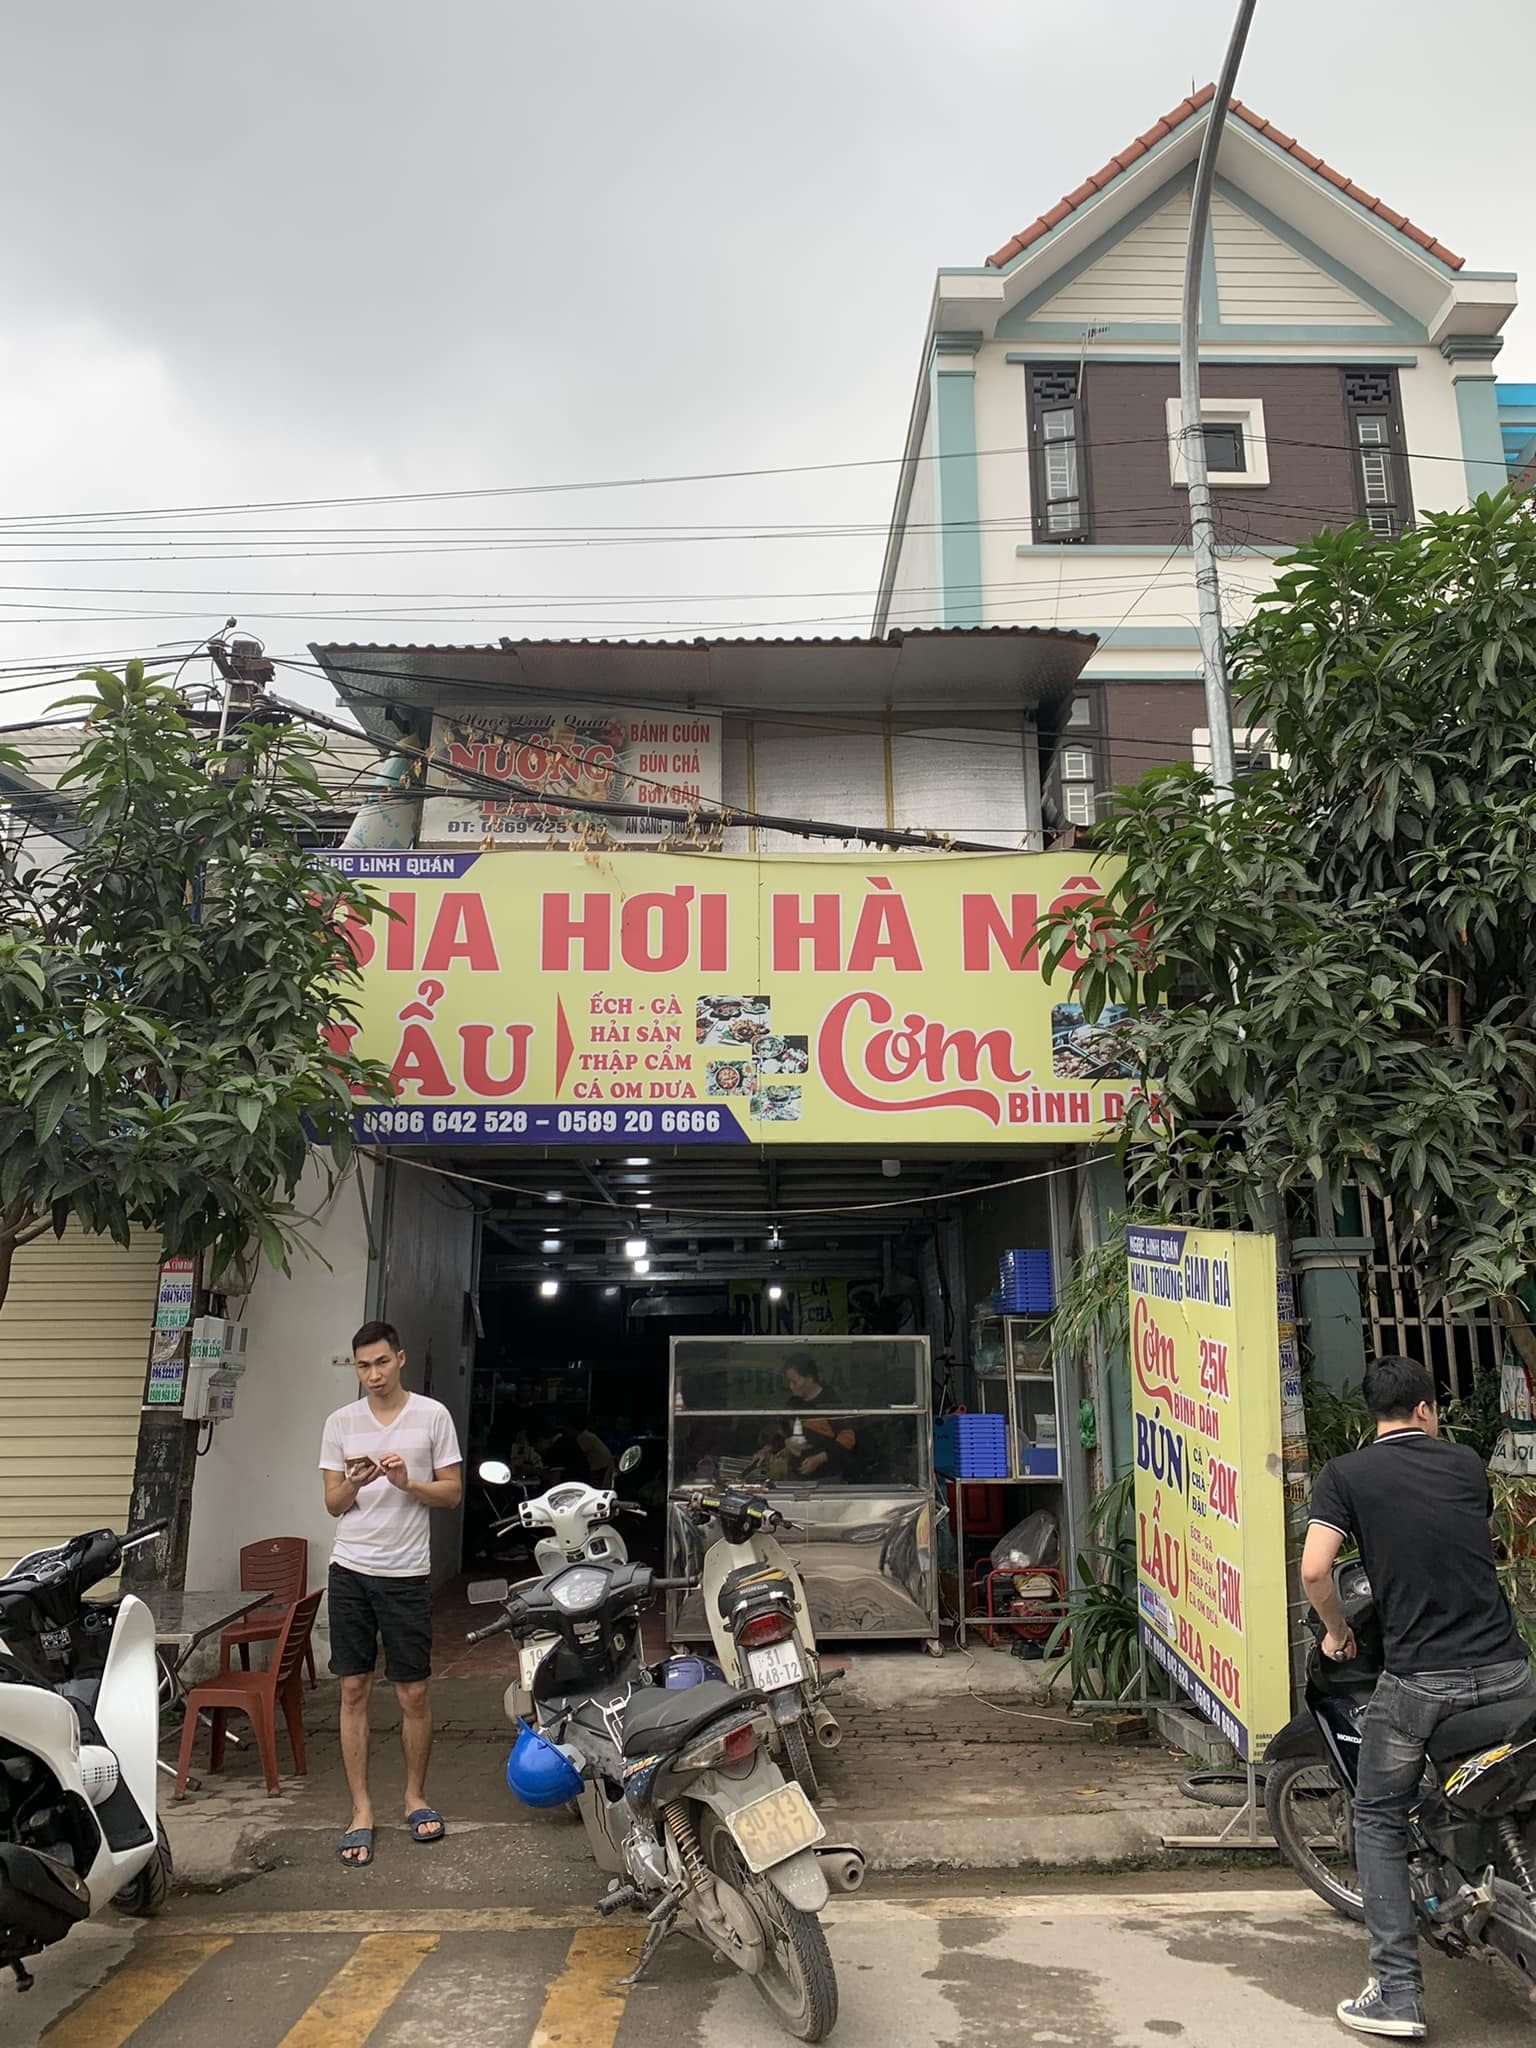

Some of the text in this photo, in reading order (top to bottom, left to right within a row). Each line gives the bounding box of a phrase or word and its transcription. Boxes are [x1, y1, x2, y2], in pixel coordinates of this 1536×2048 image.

[631, 717, 711, 743] BÁNH CUỐN
[639, 748, 700, 773] BÚN CHẢ
[448, 821, 475, 834] ĐT:
[533, 820, 568, 835] 425
[360, 857, 401, 873] LINH
[406, 856, 455, 875] QUÁN
[307, 892, 499, 972] BIA
[540, 885, 728, 973] HƠI
[772, 876, 923, 972] HÀ
[590, 991, 633, 1015] ẾCH
[651, 994, 682, 1015] GÀ
[319, 979, 535, 1097] LẨU
[590, 1019, 681, 1042] HẢI SẢN
[579, 1045, 692, 1075] THẬP CẨM
[818, 991, 1031, 1126] Cơm
[573, 1078, 697, 1099] CÁ OM DƯA
[1008, 1087, 1090, 1123] BÌNH
[363, 1110, 424, 1133] 0986
[432, 1110, 477, 1132] 642
[484, 1110, 528, 1132] 528
[557, 1110, 617, 1132] 0589
[624, 1110, 653, 1132] 20
[661, 1110, 721, 1132] 6666
[1145, 1237, 1160, 1257] LINH
[1160, 1237, 1179, 1260] QUÁN
[1130, 1262, 1148, 1294] KHAI
[1184, 1241, 1210, 1303] GIẢM
[1212, 1250, 1231, 1307] GIÁ
[1133, 1297, 1179, 1418] Cơm
[1199, 1338, 1230, 1398] 25K
[1174, 1391, 1196, 1427] BÌNH
[1136, 1406, 1184, 1496] BÚN
[1208, 1457, 1239, 1524] 20K
[1139, 1489, 1181, 1599] LẨU
[1216, 1557, 1242, 1633] 150K
[758, 1661, 800, 1689] 648-T2
[766, 1648, 781, 1667] 31
[1178, 1614, 1241, 1710] BIA HƠI
